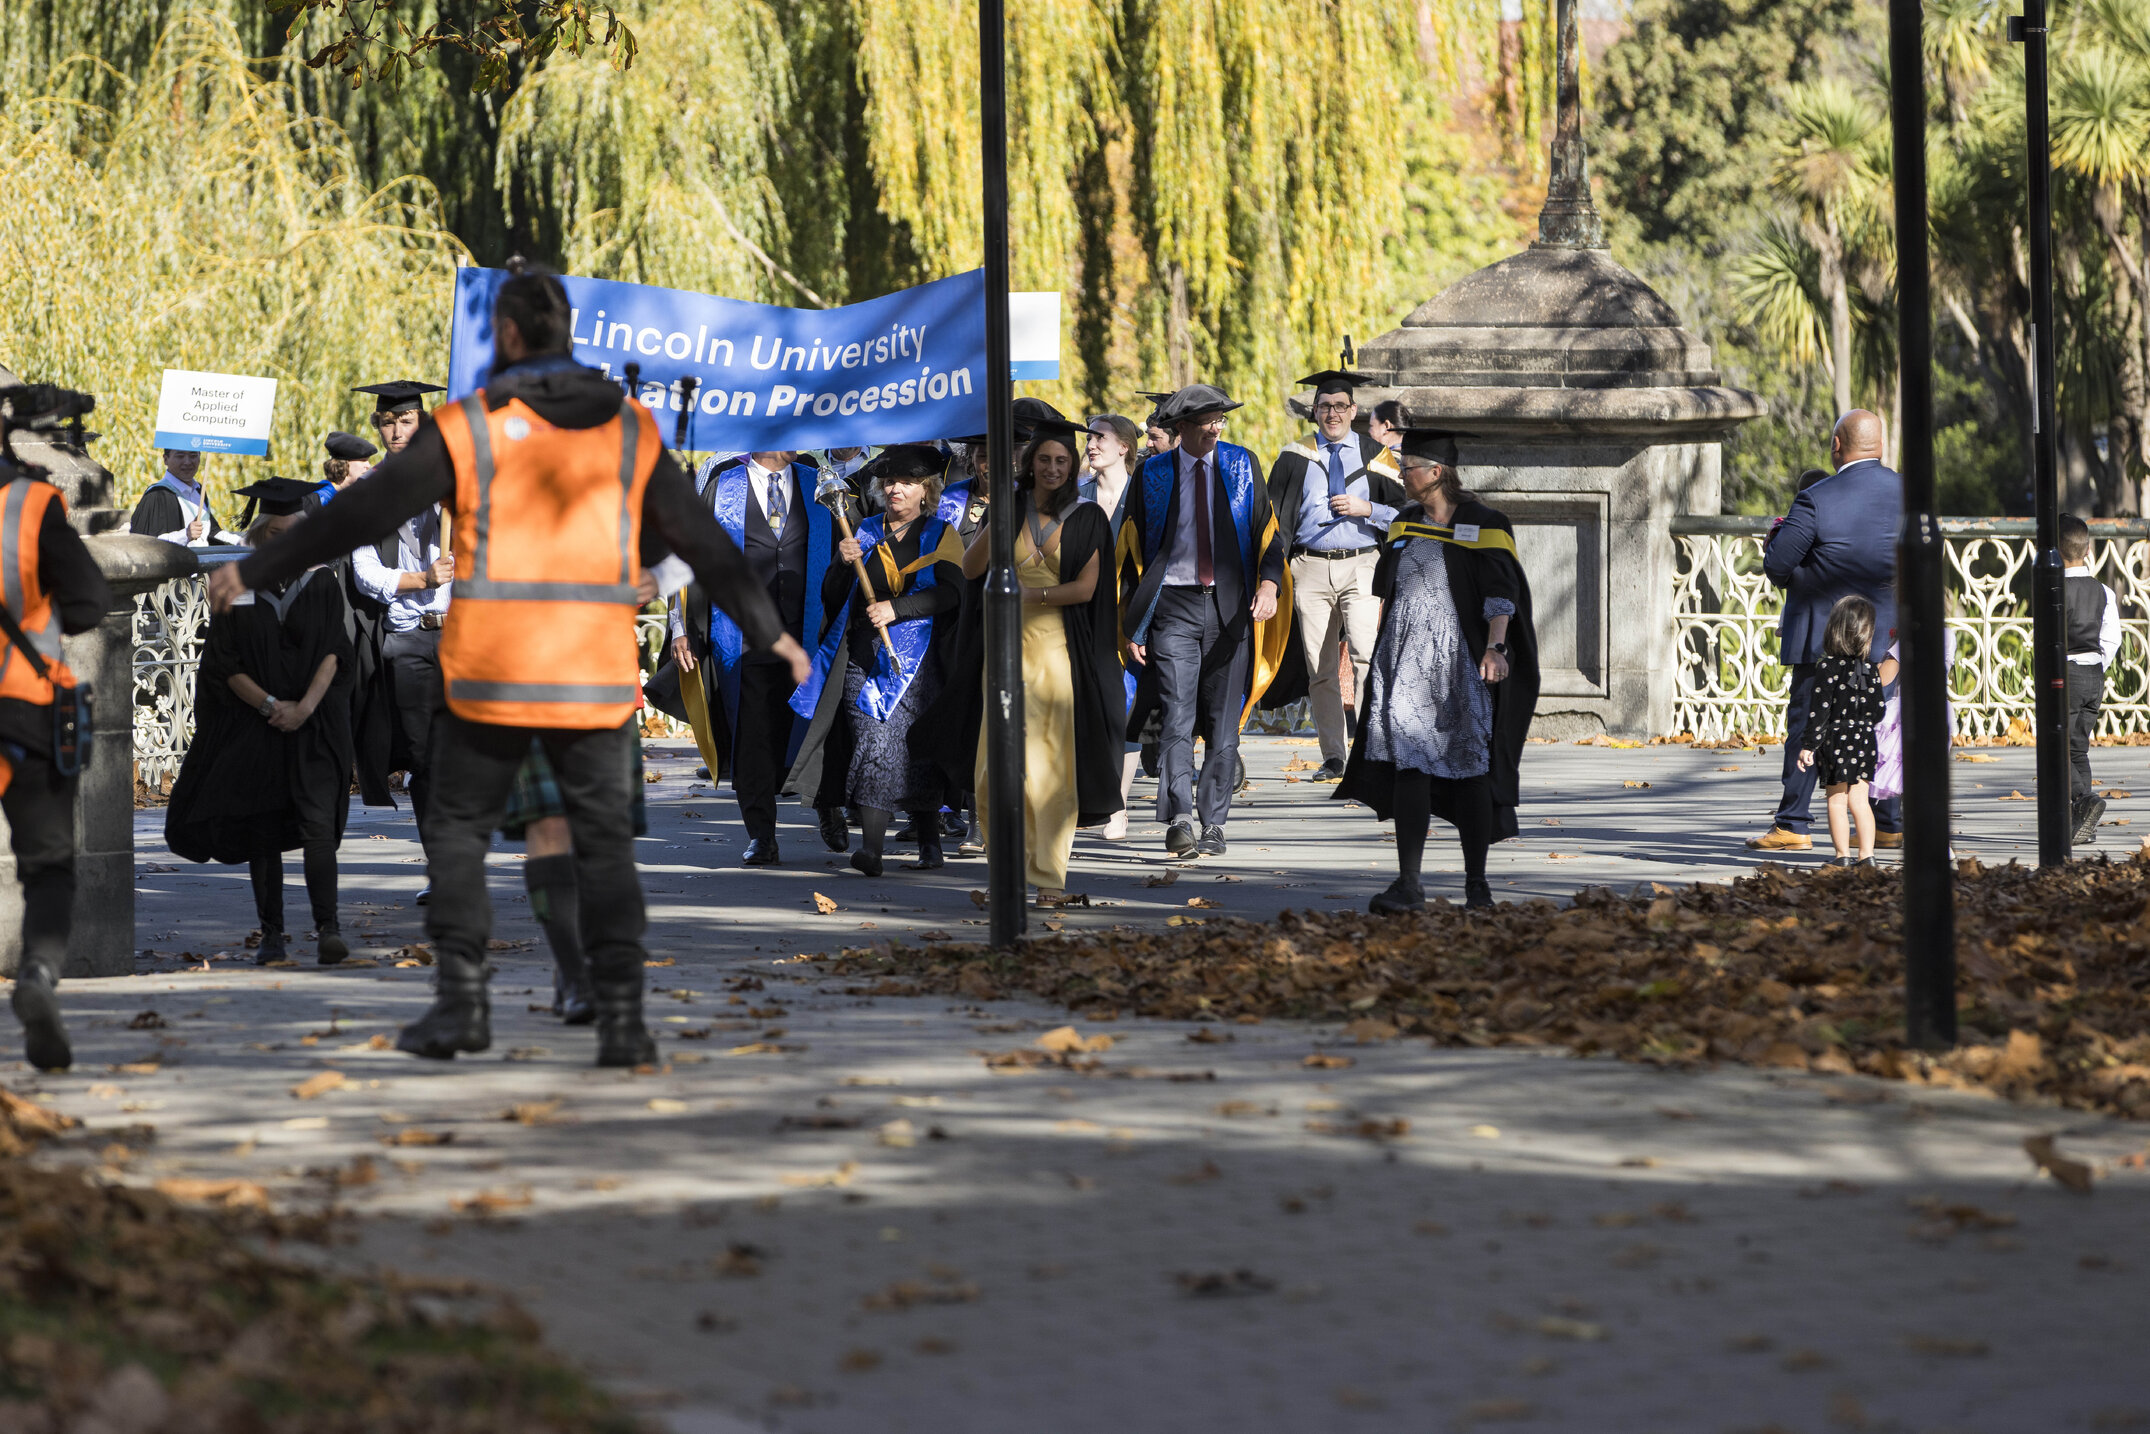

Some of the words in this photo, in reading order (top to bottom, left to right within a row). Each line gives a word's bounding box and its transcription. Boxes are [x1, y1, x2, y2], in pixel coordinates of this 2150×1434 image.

[570, 308, 734, 367] Lincoln
[749, 323, 927, 371] University
[191, 387, 230, 399] Master
[233, 390, 245, 400] of
[765, 366, 973, 417] Procession
[193, 400, 239, 413] Applied
[182, 412, 246, 428] Computing
